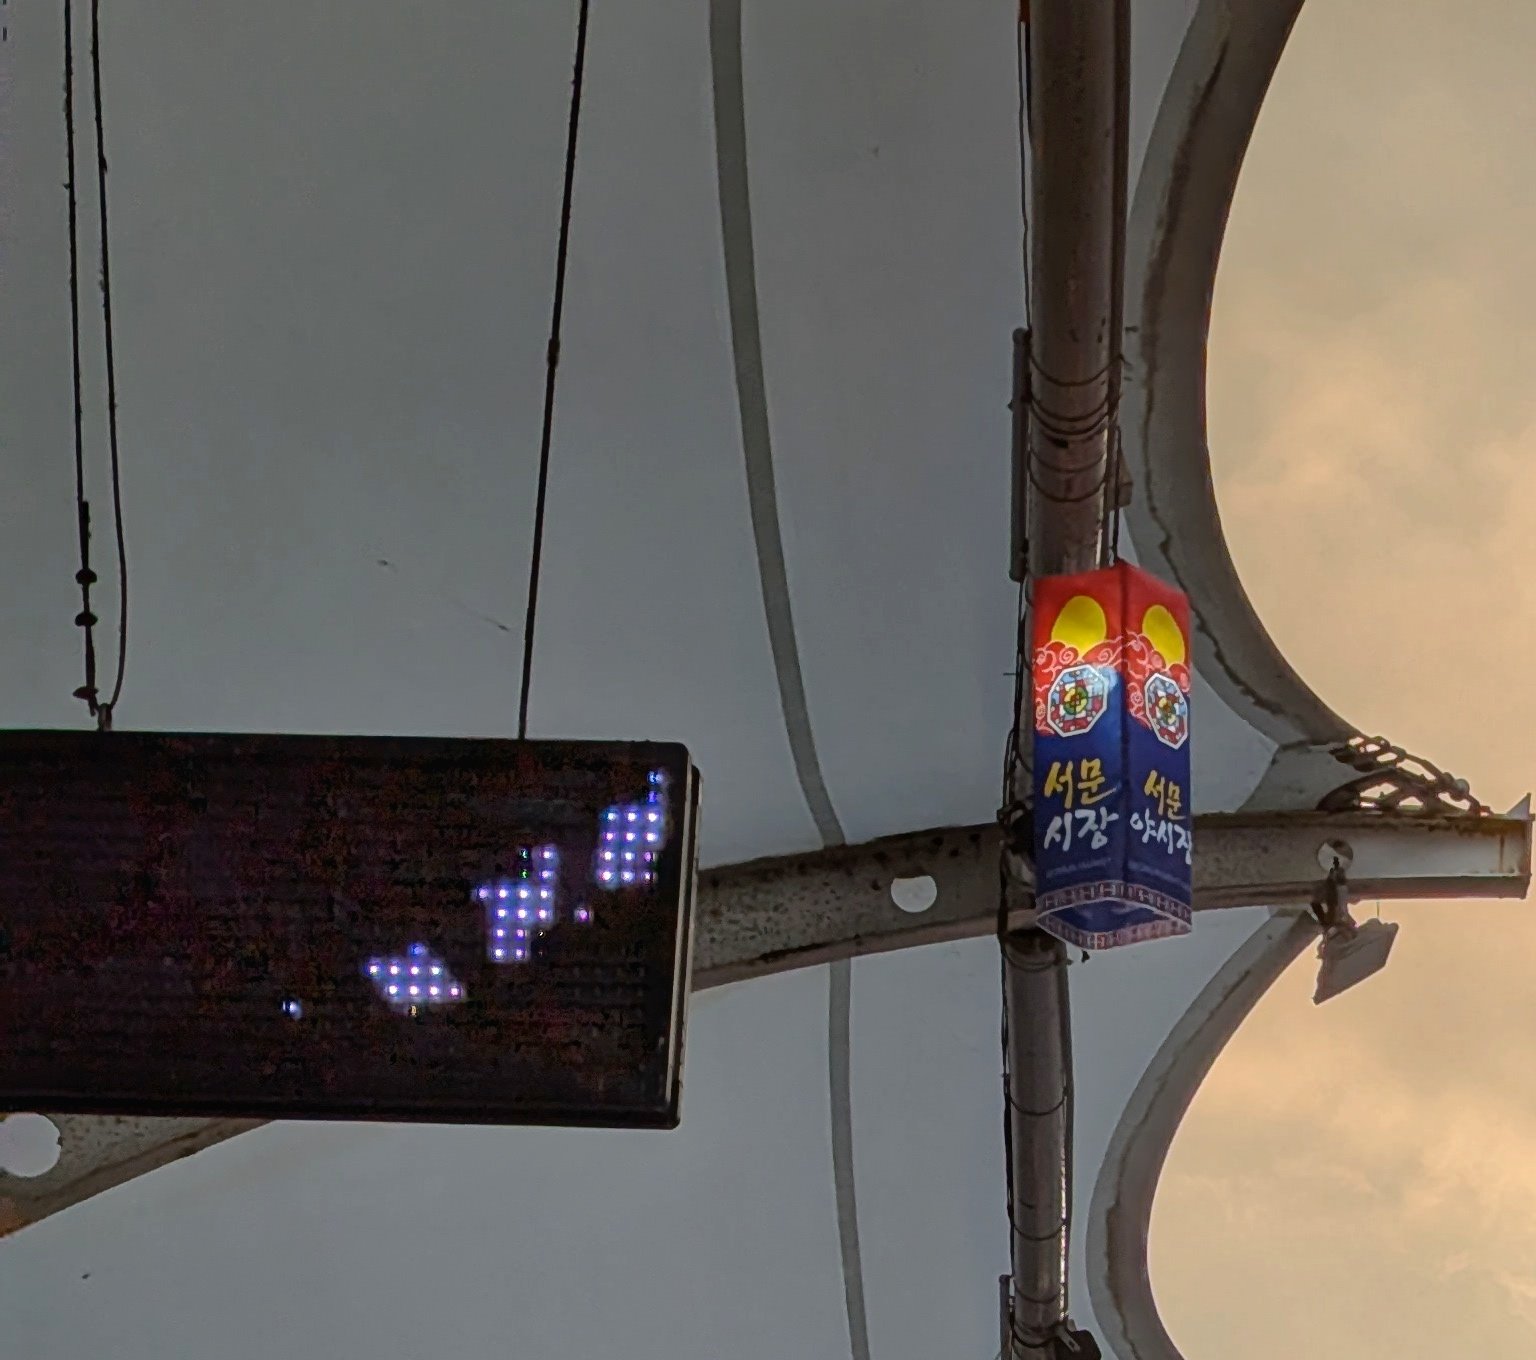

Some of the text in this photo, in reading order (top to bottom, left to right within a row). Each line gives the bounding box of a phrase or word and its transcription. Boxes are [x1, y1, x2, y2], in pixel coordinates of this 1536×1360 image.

[1044, 758, 1117, 809] 서문
[1143, 769, 1187, 821] 서문
[1044, 809, 1119, 851] 시장
[1130, 813, 1192, 866] 야시장
